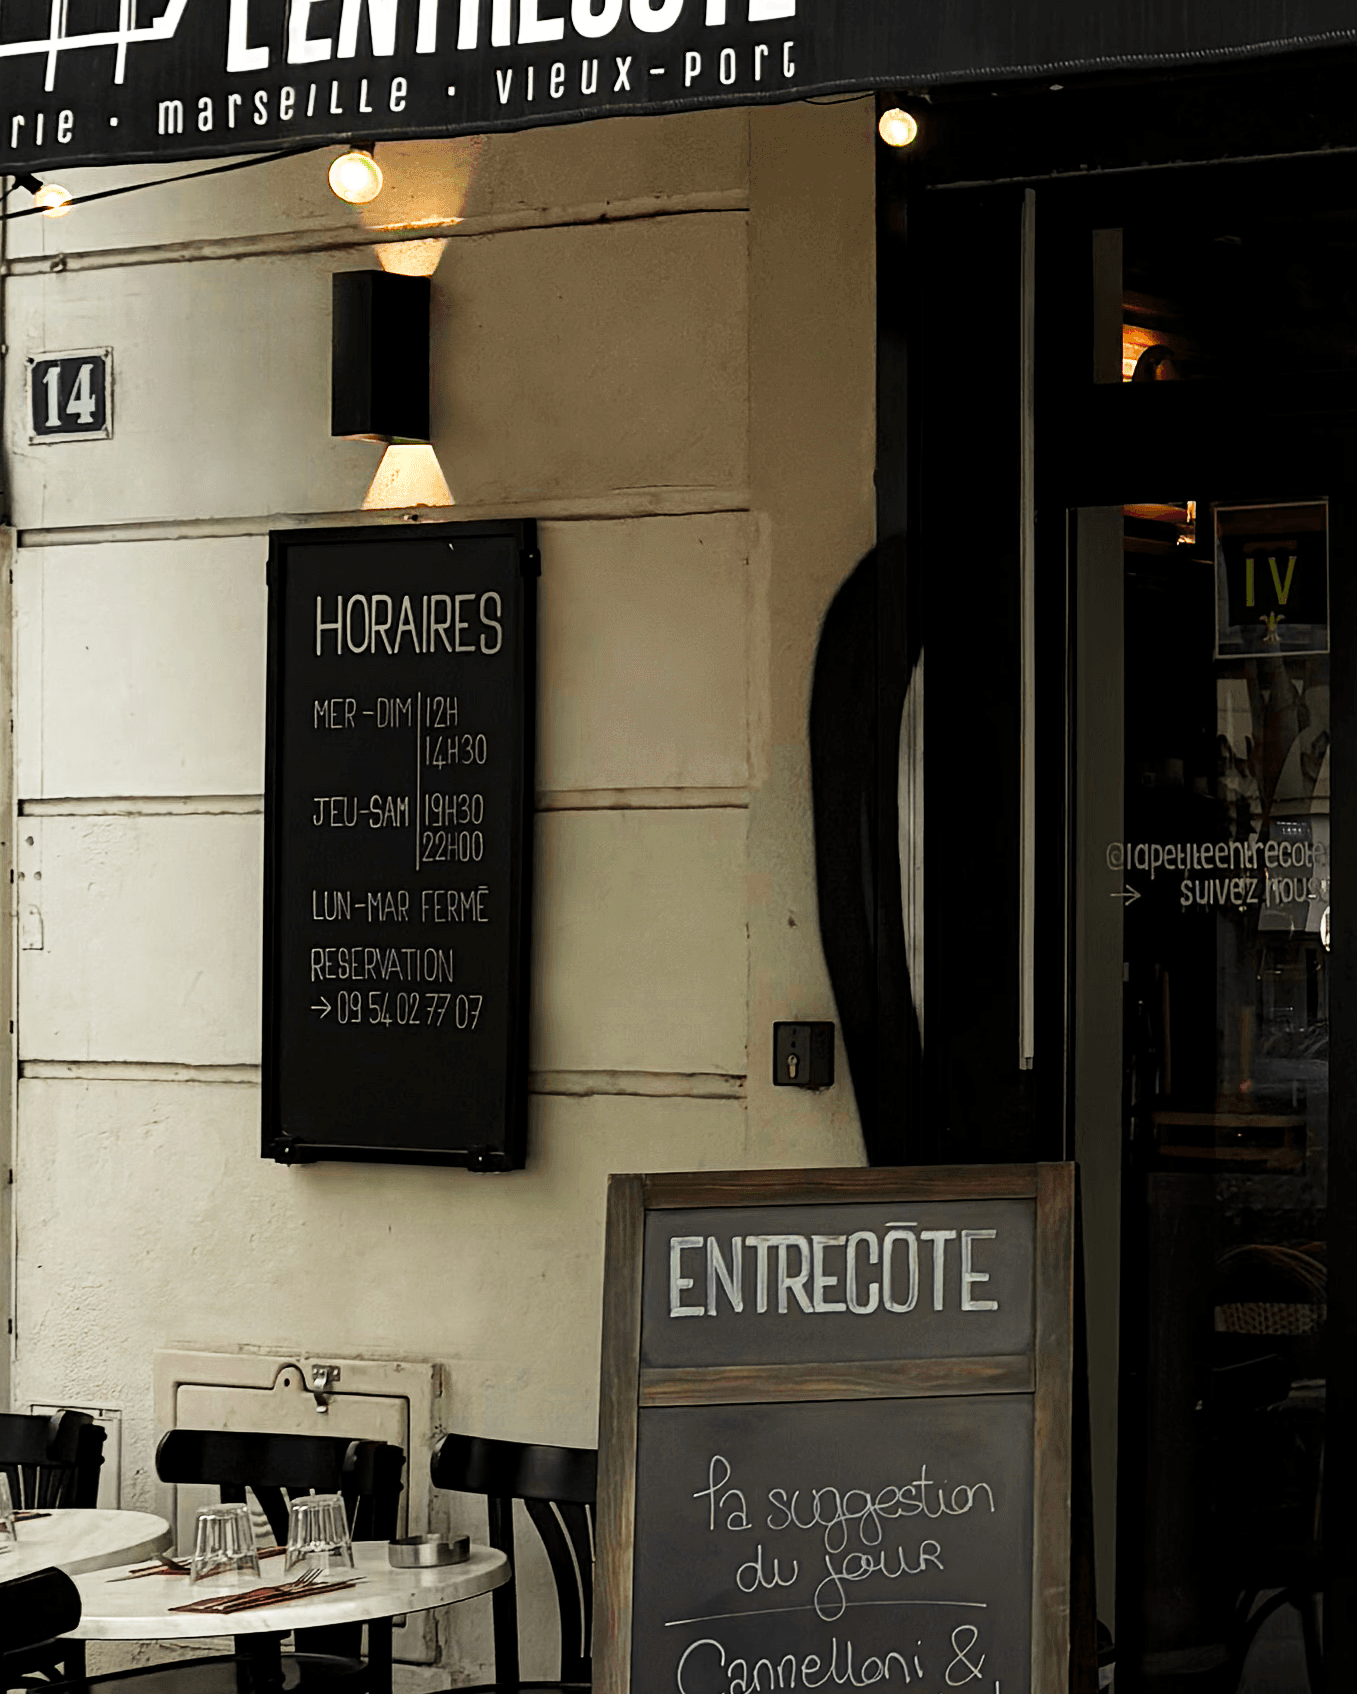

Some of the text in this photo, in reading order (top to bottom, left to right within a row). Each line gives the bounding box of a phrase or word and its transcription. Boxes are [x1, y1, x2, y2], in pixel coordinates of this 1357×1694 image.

[158, 76, 408, 135] marseille
[496, 41, 795, 104] vieux-port
[42, 363, 96, 427] 14
[315, 591, 503, 657] HORAIRES
[425, 695, 459, 729] 12H
[425, 733, 488, 770] 14H30
[424, 792, 485, 827] 19H30
[421, 830, 485, 863] 22H00
[1179, 877, 1260, 907] suivez
[310, 947, 454, 984] RESERVATION
[766, 1464, 996, 1554] suggestion
[735, 1543, 799, 1594] du
[676, 1624, 987, 1694] Cannelloni &
